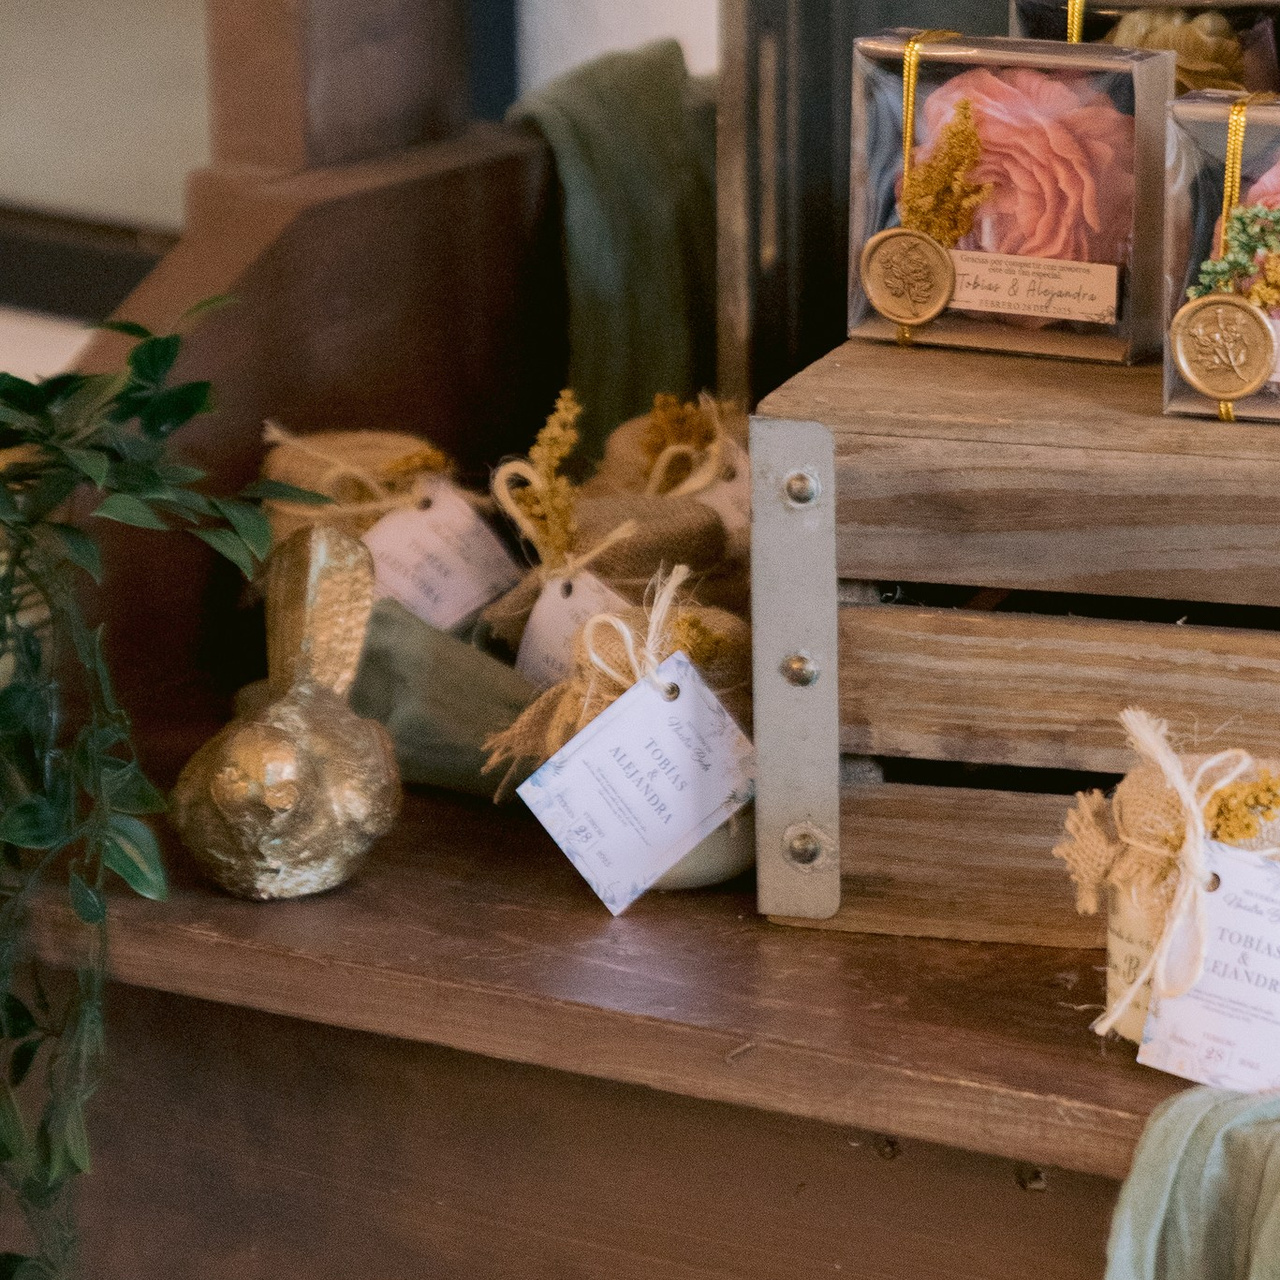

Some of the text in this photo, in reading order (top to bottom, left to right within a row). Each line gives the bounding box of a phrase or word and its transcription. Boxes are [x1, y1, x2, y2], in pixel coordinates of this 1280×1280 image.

[1007, 278, 1019, 297] &
[1026, 279, 1097, 309] Alejandra
[644, 737, 688, 792] TOBÍAS
[647, 769, 658, 782] &
[609, 746, 673, 825] ALEJANDRA
[574, 825, 592, 843] 28
[1237, 951, 1250, 967] &
